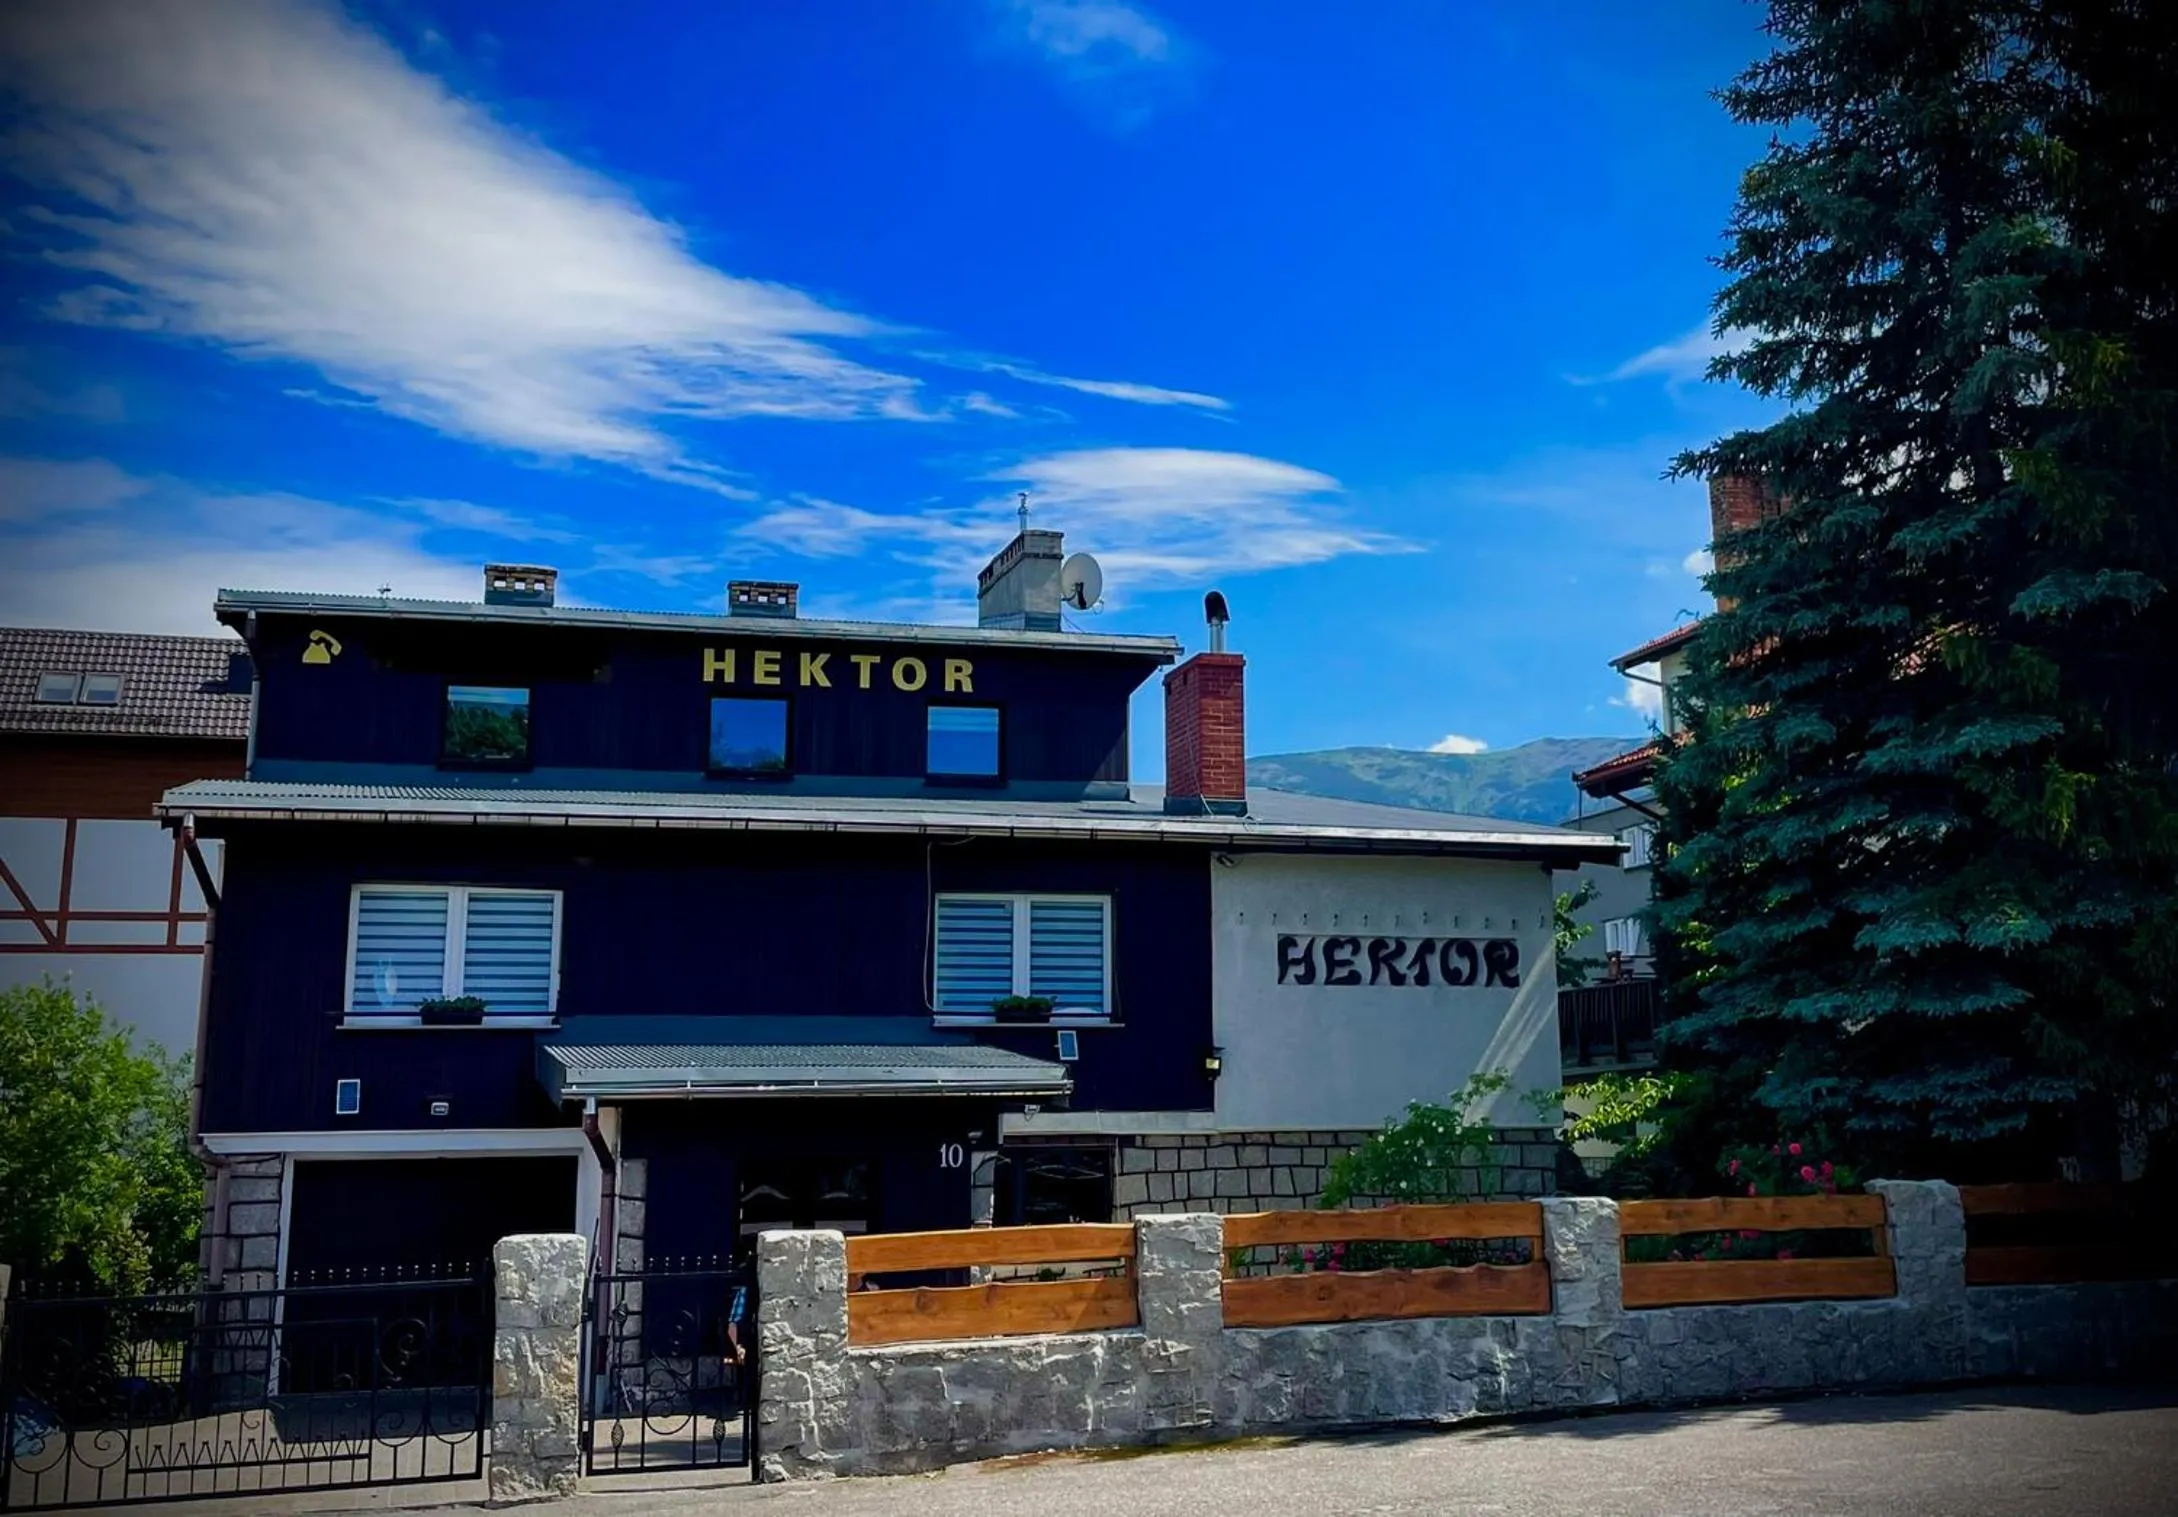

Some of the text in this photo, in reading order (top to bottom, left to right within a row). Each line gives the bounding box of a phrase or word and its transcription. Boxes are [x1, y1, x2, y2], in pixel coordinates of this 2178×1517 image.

[702, 648, 974, 693] HEKTOR
[1278, 936, 1520, 988] HEKTOR
[940, 1143, 964, 1168] 10
